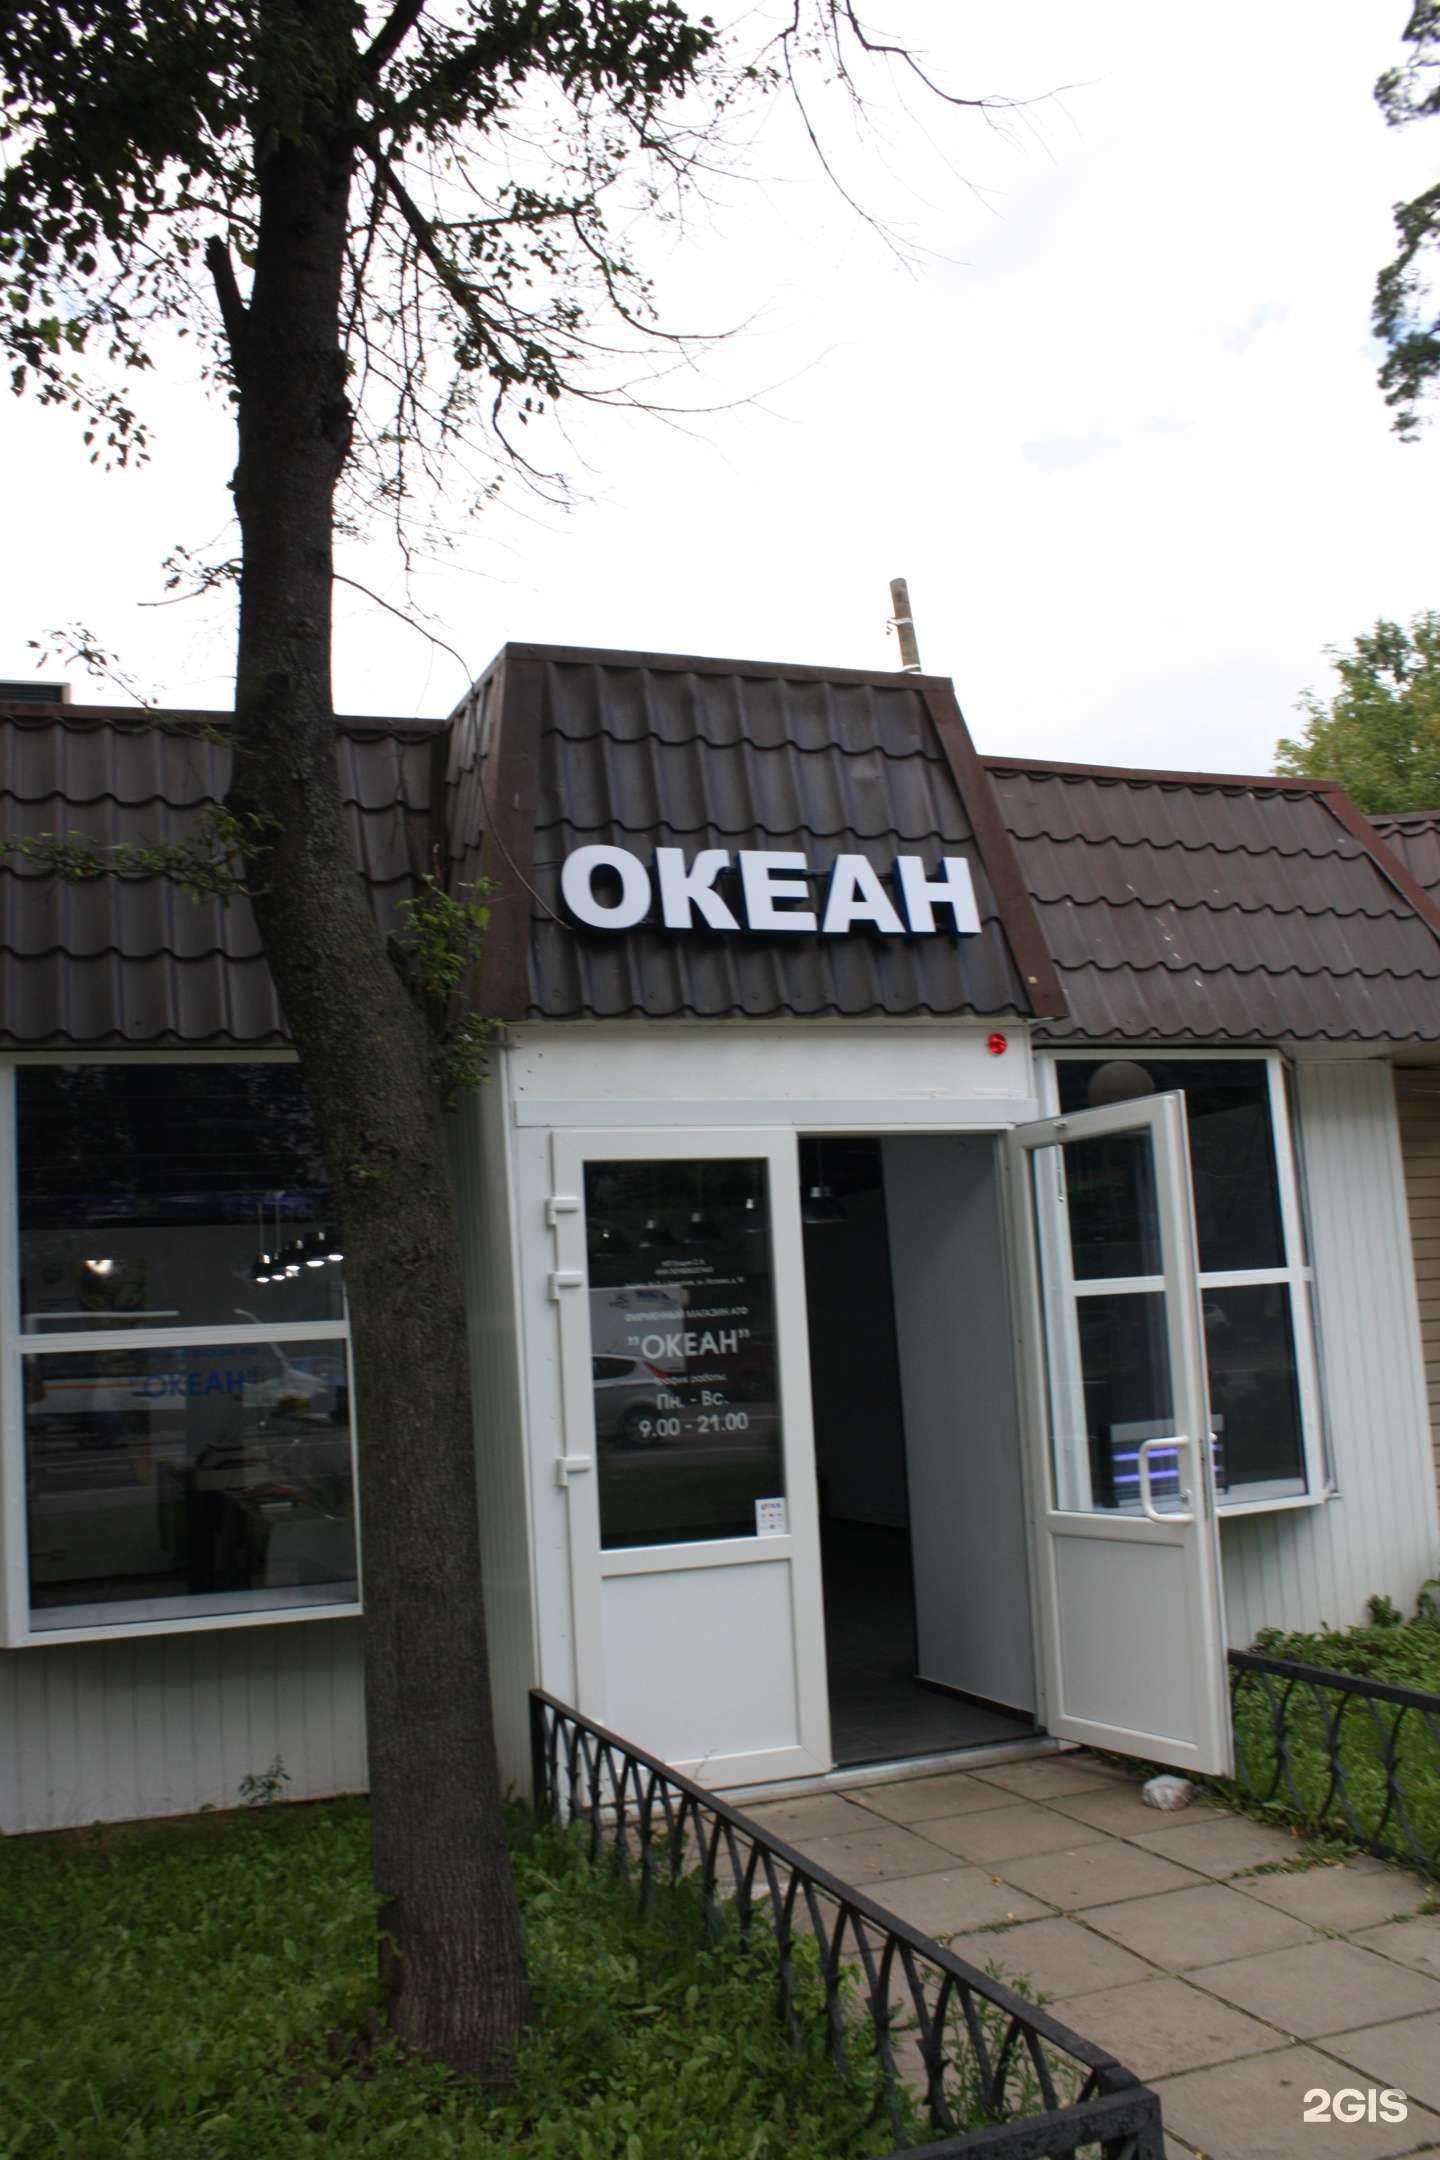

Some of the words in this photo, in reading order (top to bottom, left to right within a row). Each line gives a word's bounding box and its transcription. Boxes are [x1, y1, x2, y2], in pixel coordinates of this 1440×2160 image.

[560, 843, 982, 936] ОКЕАН
[656, 1393, 685, 1410] Пн.
[701, 1390, 730, 1406] Вс.
[639, 1418, 680, 1438] 9.00
[697, 1412, 749, 1433] 21.00
